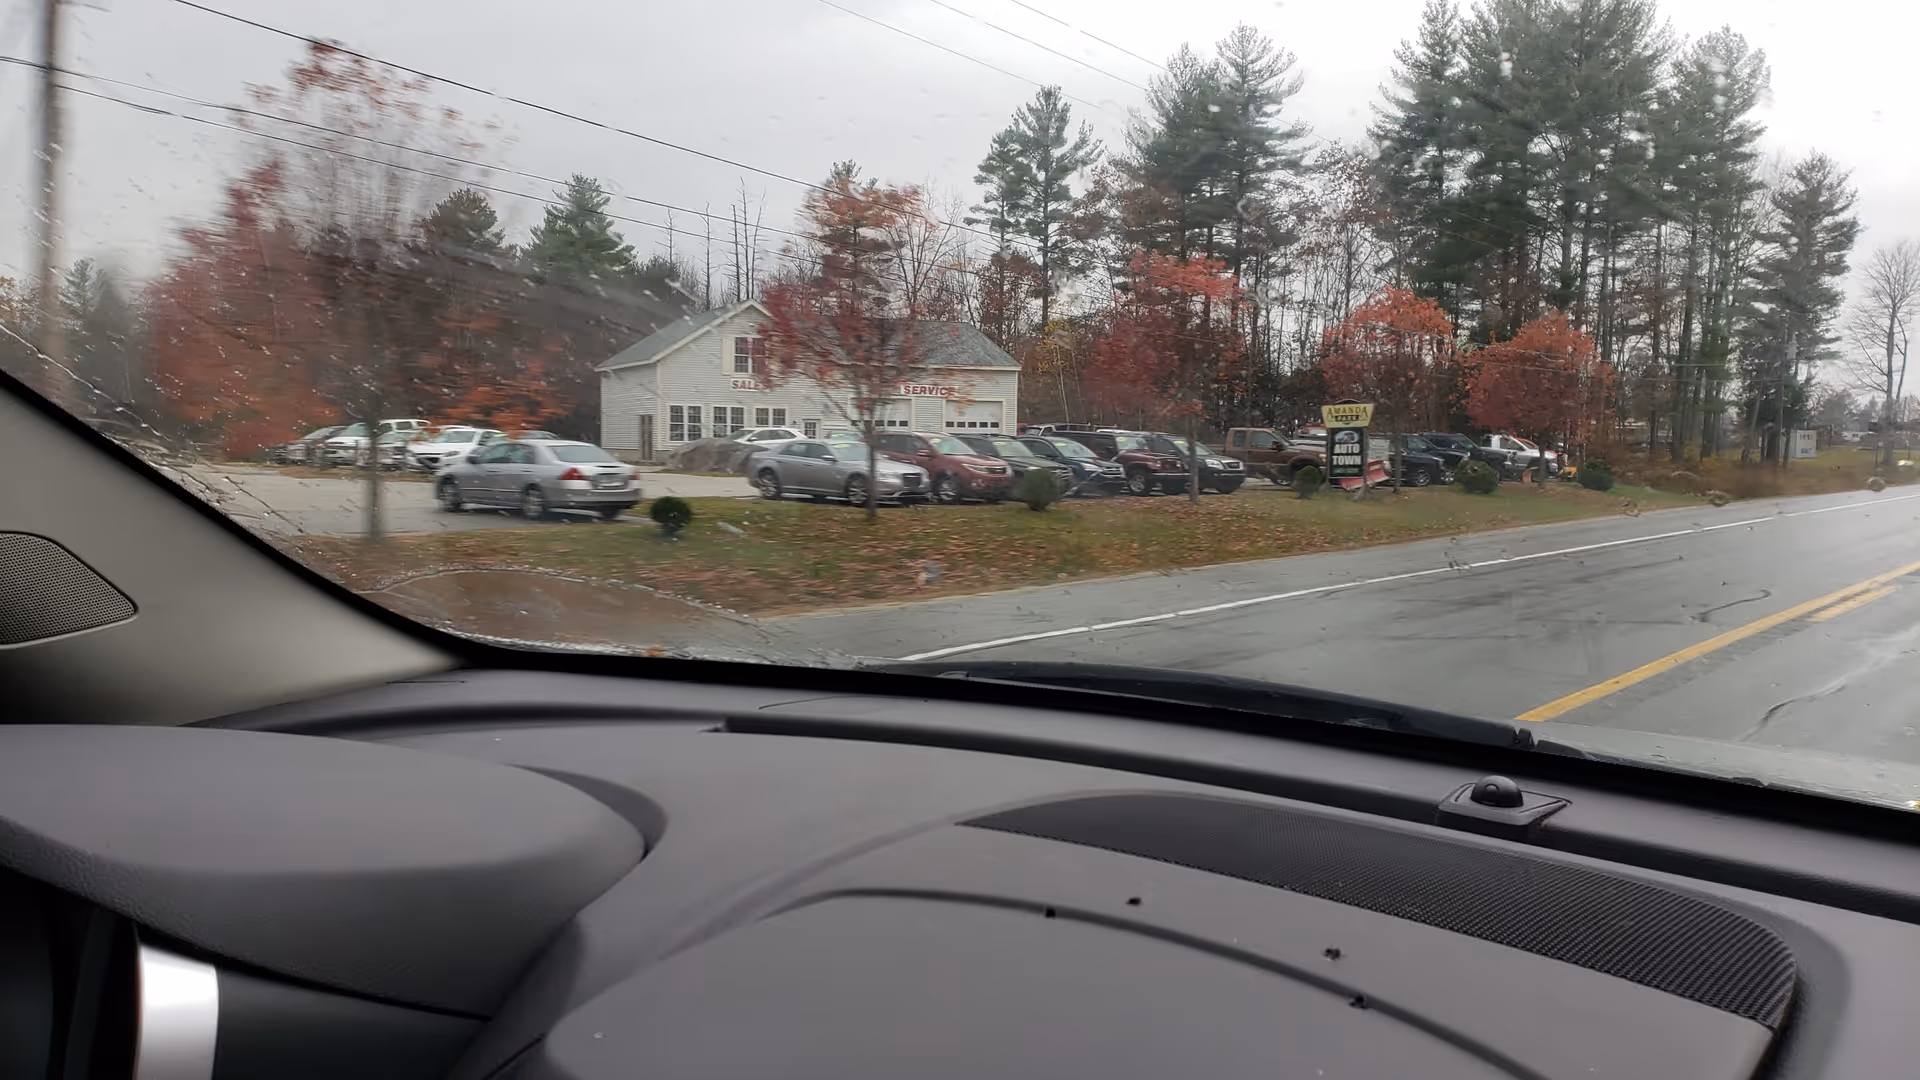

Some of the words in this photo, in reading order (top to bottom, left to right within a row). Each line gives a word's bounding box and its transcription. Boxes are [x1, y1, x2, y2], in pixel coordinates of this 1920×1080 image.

[732, 379, 769, 390] SALES
[903, 385, 956, 396] SERVICE
[1327, 406, 1368, 418] AMANDA
[1334, 443, 1360, 454] AUTO
[1332, 455, 1361, 465] TOWN
